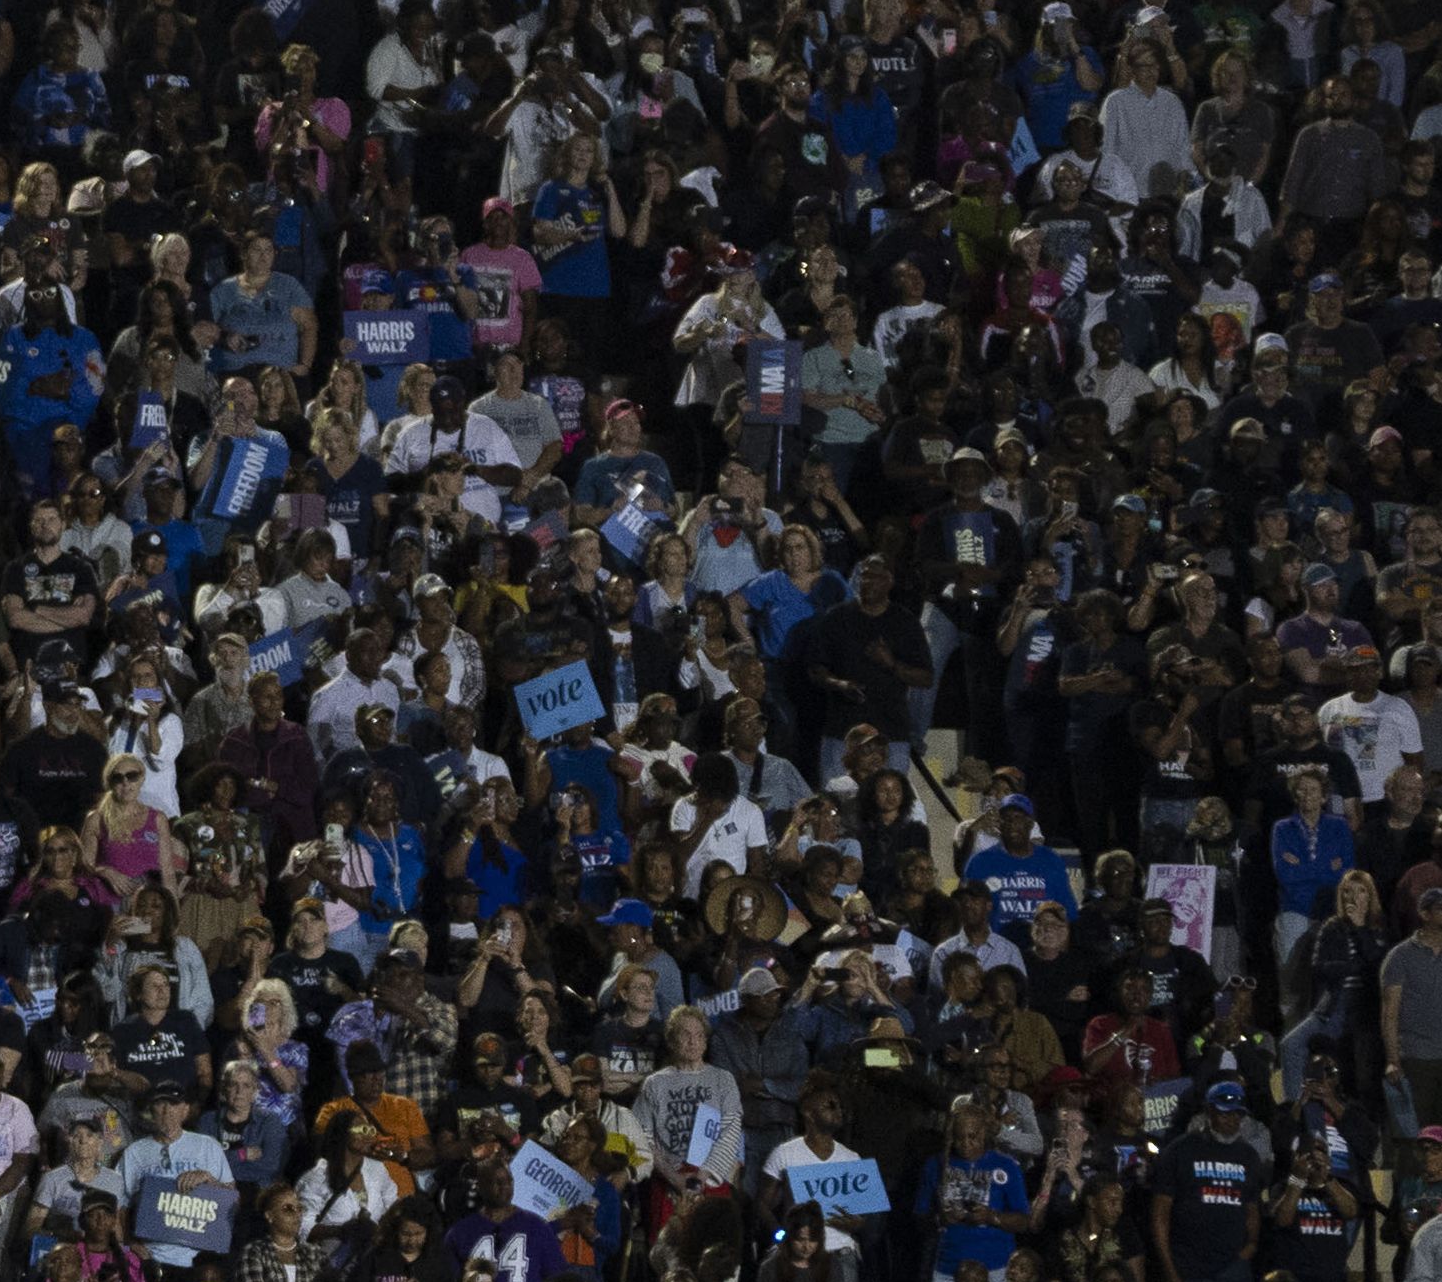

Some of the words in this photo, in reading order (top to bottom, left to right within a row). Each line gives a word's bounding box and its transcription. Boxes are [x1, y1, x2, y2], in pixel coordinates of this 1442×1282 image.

[357, 320, 416, 343] HARRIS
[365, 340, 408, 355] WALZ
[140, 404, 167, 427] FREE
[229, 442, 270, 516] FREEDOM
[526, 675, 584, 718] vote
[525, 1157, 585, 1205] GEORGIA
[1193, 1161, 1250, 1181] HARRIS
[802, 1174, 869, 1201] vote
[1201, 1186, 1242, 1207] WALZ
[157, 1192, 219, 1222] HARRIS
[164, 1212, 207, 1234] WALZ
[1299, 1219, 1343, 1236] WALZ
